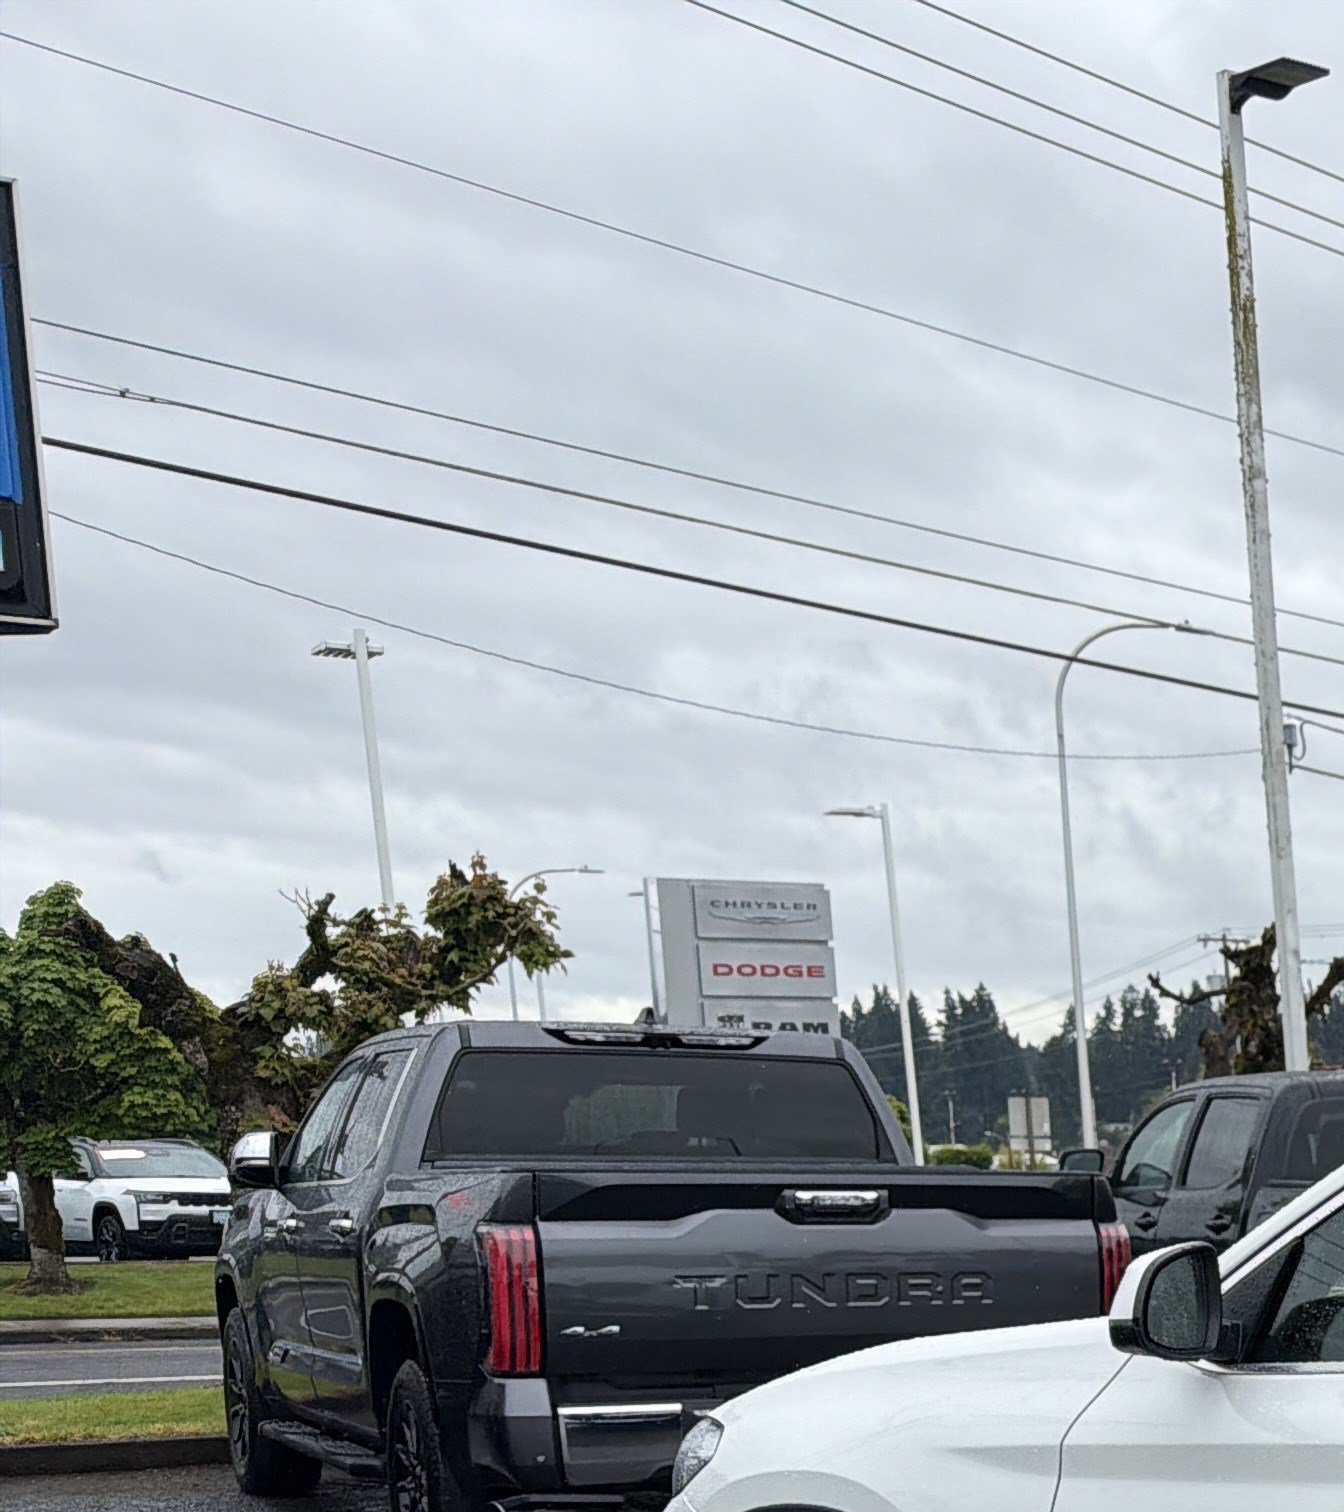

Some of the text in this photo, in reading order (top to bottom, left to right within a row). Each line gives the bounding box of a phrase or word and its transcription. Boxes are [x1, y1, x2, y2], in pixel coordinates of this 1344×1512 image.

[710, 899, 818, 911] CHRYSLER
[712, 963, 826, 979] DODGE
[672, 1272, 994, 1311] TUNDRA
